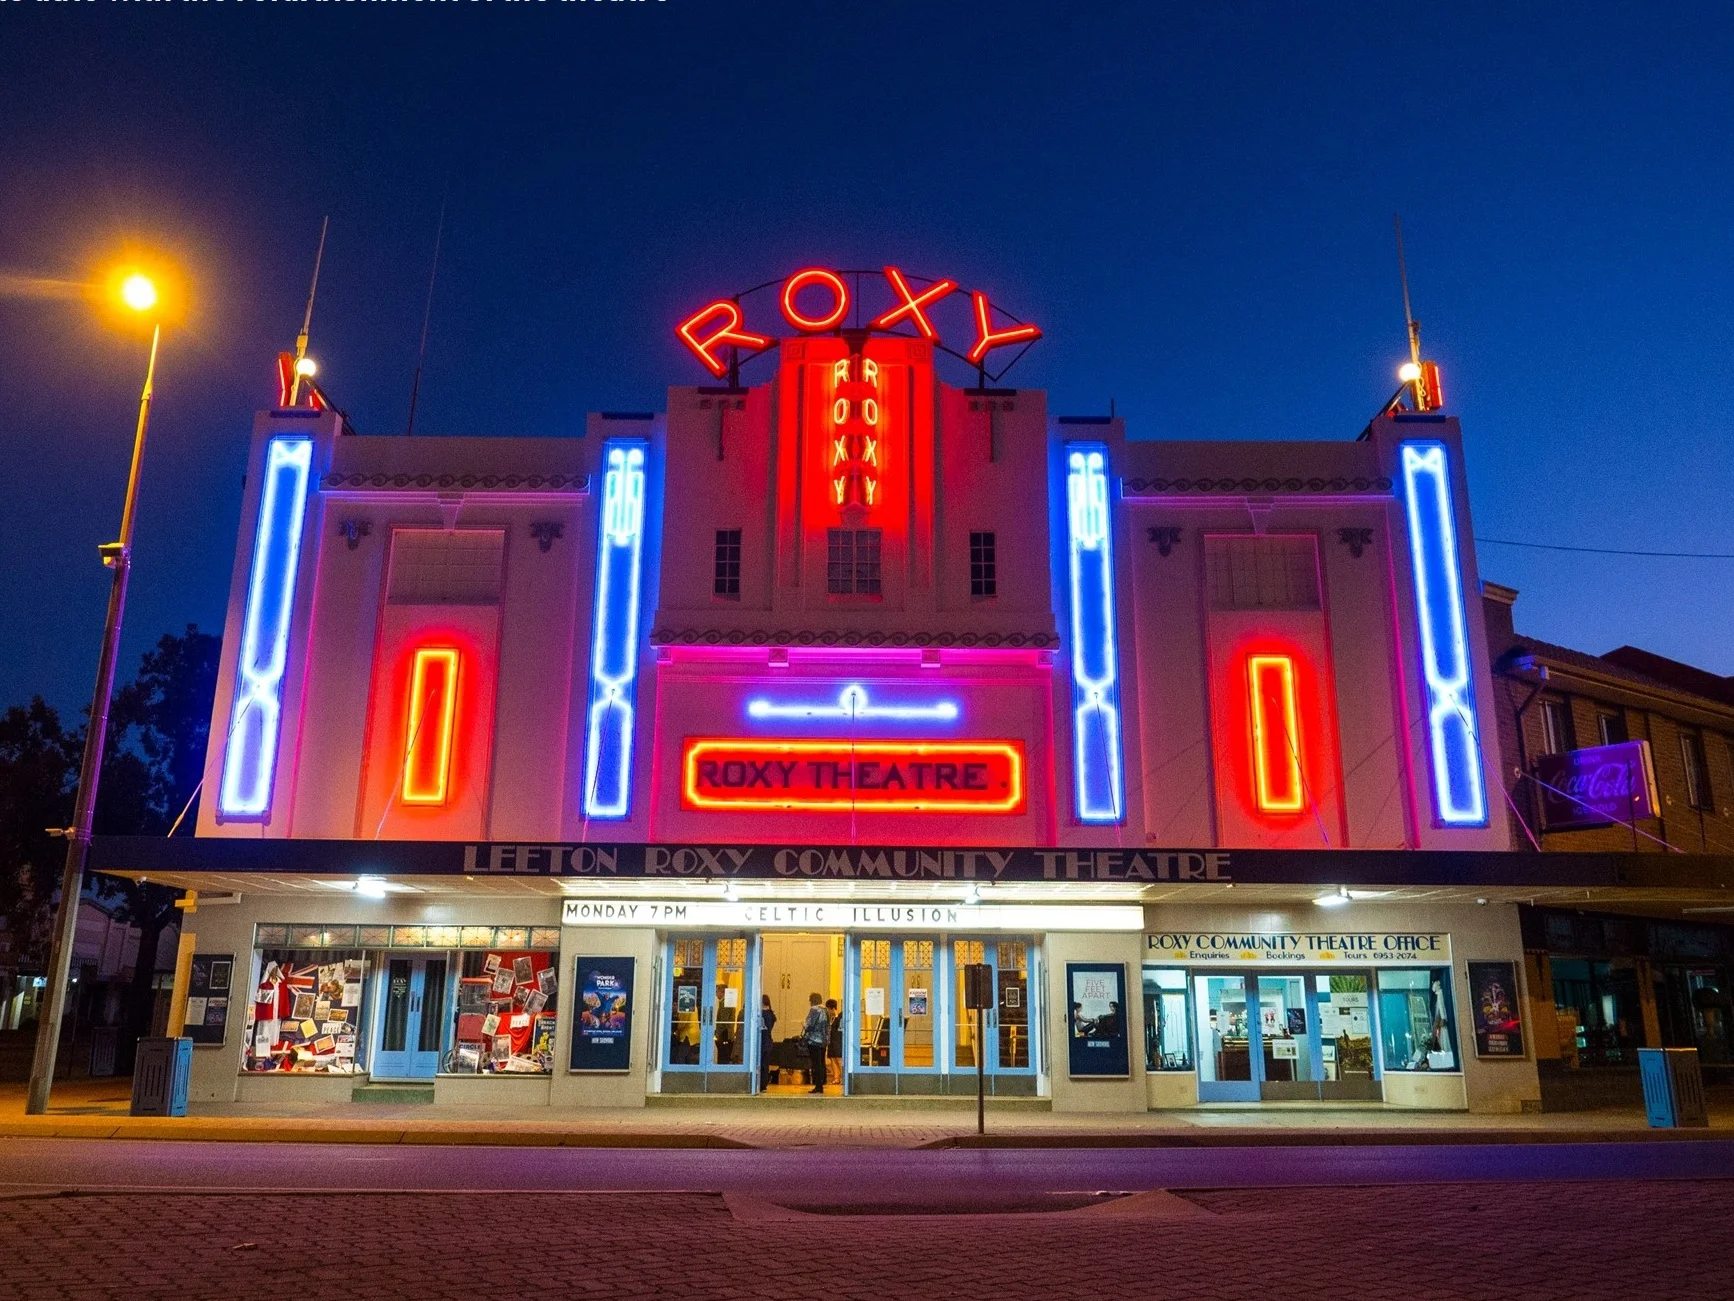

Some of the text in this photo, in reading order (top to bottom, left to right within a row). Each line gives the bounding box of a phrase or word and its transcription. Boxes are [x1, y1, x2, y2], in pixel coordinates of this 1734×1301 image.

[675, 266, 1043, 380] ROXY
[833, 358, 851, 505] ROXY
[861, 358, 878, 506] ROXY
[697, 760, 988, 790] ROXY THEATRE
[463, 845, 1232, 880] LEETON ROXY COMMUNITY THEATRE
[566, 904, 638, 919] MONDAY
[744, 906, 824, 922] CELTIC
[852, 907, 957, 923] ILLUSION
[1148, 934, 1440, 951] ROXY COMMUNITY THEATRE OFFICE
[1189, 951, 1230, 960] Enquiries
[1266, 951, 1306, 960] Bookings
[1343, 951, 1367, 960] Tours
[1085, 985, 1106, 993] FEET
